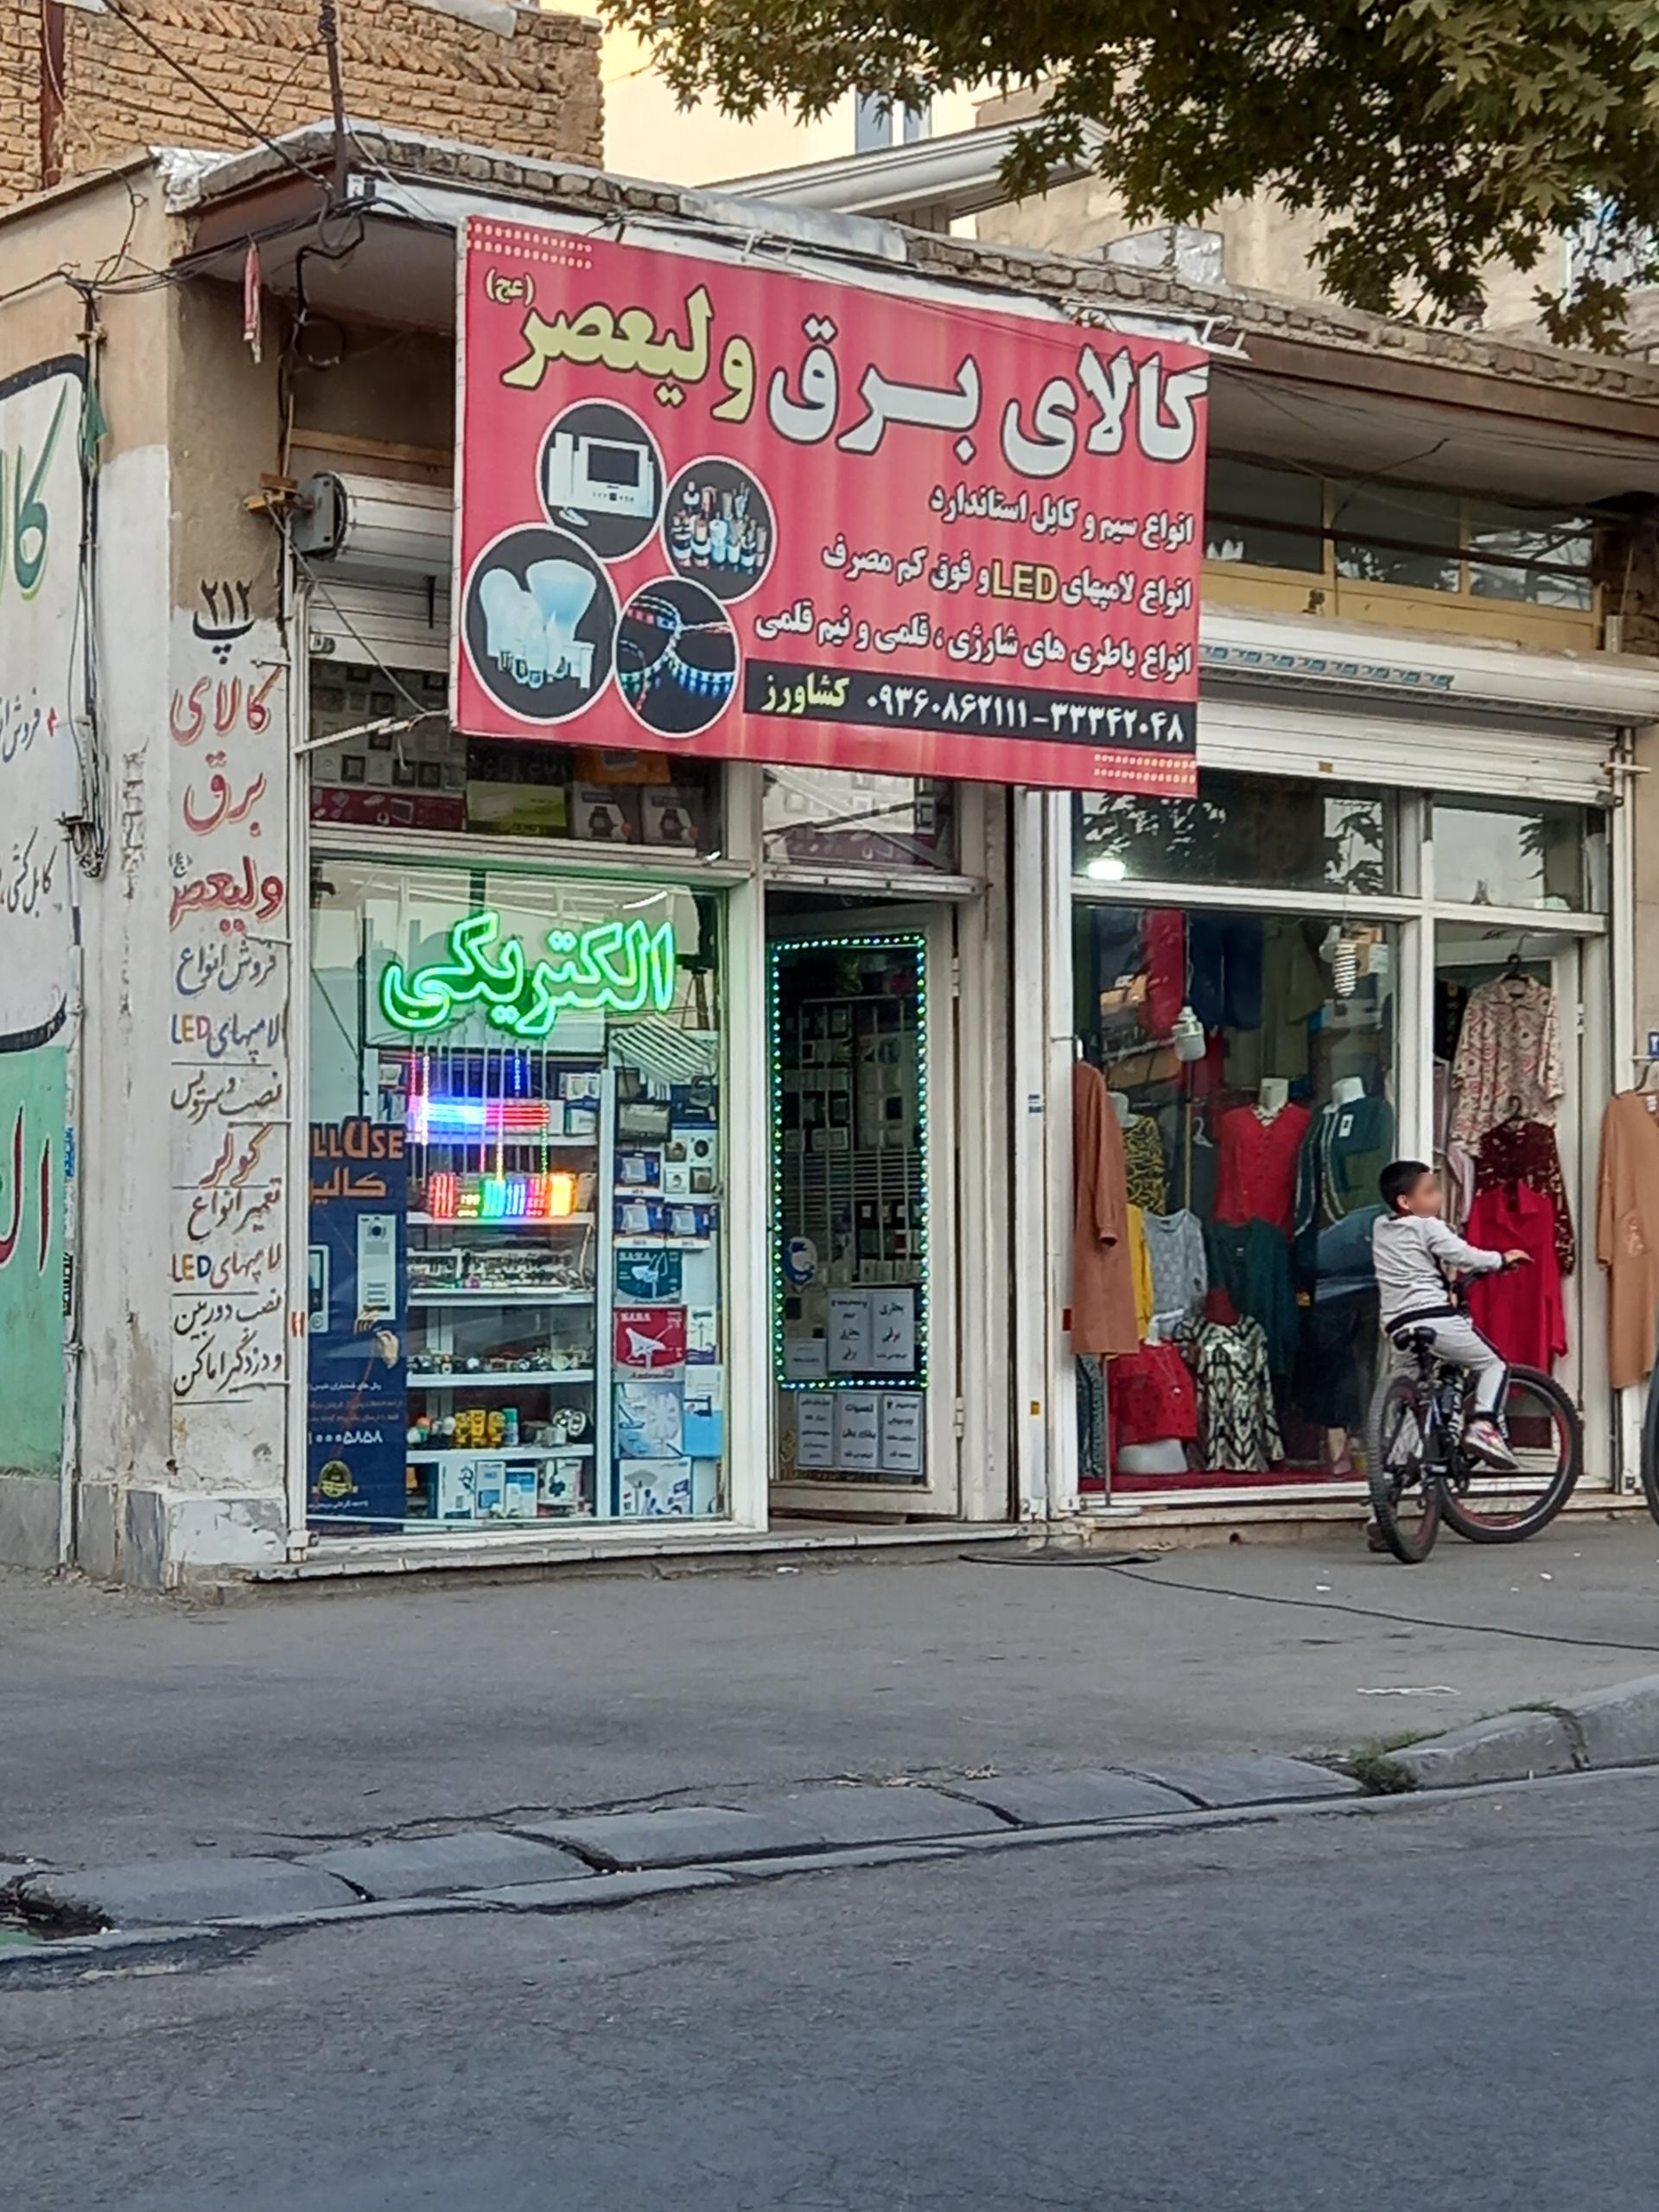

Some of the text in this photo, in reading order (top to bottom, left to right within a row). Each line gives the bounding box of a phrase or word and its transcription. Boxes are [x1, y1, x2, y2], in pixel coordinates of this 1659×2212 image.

[486, 267, 534, 307] (عج)
[767, 314, 982, 465] برق
[1001, 343, 1208, 480] کالای
[929, 484, 1195, 553] انواع سیم و کابل استاندارد
[821, 533, 1192, 617] انواع لامپهای LED و فوق کم مصرف
[754, 600, 814, 640] قلمی
[817, 606, 852, 645] نیم
[855, 617, 868, 650] و
[874, 612, 931, 652] قلمی
[1023, 630, 1067, 671] های
[1070, 634, 1137, 675] باطری
[1141, 641, 1192, 683] انواع
[169, 665, 283, 746] کالای
[761, 665, 850, 715] کشاورز
[3, 687, 41, 763] فروش
[183, 750, 266, 836] برق
[176, 940, 276, 995] فروش انواع
[380, 911, 676, 1035] الکتریکی
[172, 1013, 280, 1064] لامپهای LED
[171, 1069, 225, 1124] سرویس
[219, 1071, 282, 1116] نصب
[199, 1123, 273, 1188] کولر
[309, 1121, 404, 1159] LLUSE
[187, 1177, 283, 1241] تعمیر انواع
[172, 1254, 212, 1282] LED
[175, 1287, 282, 1340] نصب دوربین
[174, 1335, 226, 1396] اماکن
[272, 1352, 283, 1372] و
